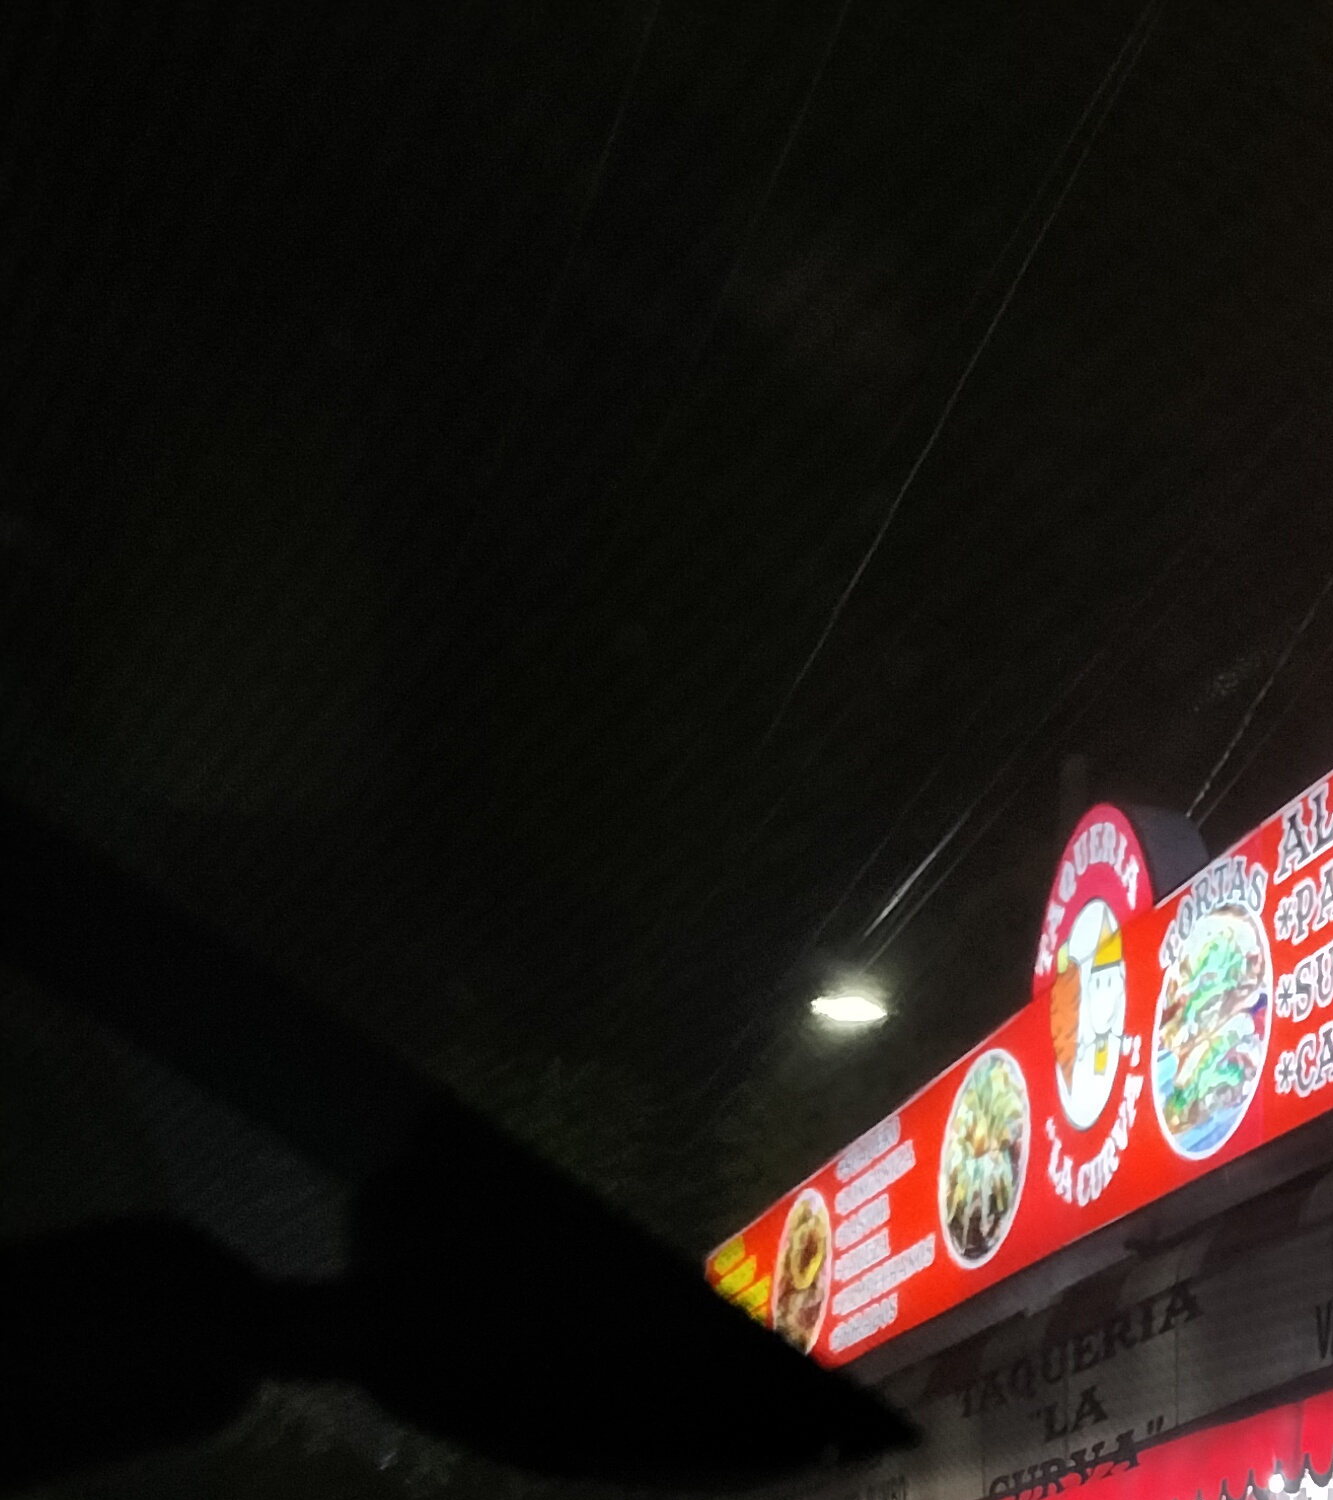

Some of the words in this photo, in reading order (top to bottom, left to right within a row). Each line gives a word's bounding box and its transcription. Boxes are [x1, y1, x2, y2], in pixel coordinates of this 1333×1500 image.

[1034, 821, 1139, 977] TAQUERIA
[1158, 855, 1268, 969] TORTAS
[959, 1278, 1205, 1420] TAQUERIA
